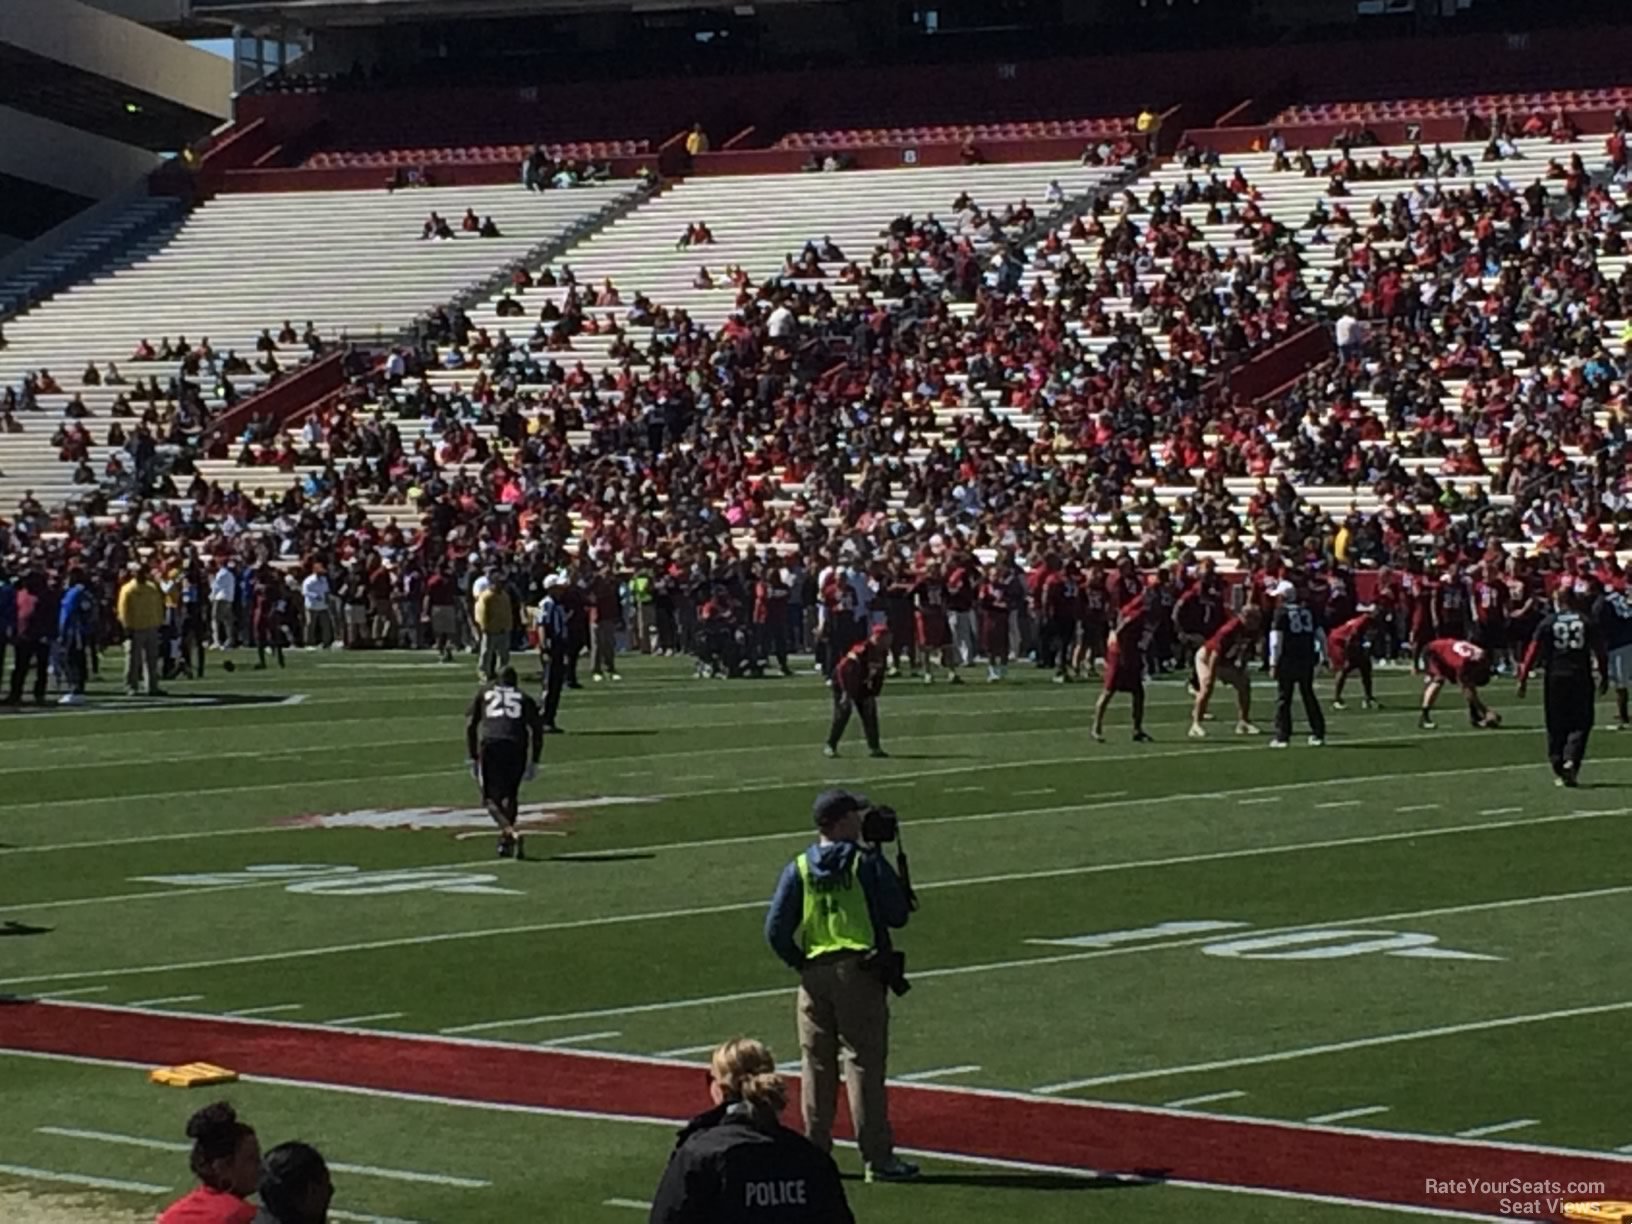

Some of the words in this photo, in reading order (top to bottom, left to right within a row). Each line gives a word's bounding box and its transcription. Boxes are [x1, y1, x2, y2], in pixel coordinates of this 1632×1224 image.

[1407, 126, 1420, 140] 7
[1288, 609, 1313, 633] 83
[1553, 621, 1584, 649] 93
[484, 690, 522, 719] 25
[745, 1180, 806, 1207] POLICE
